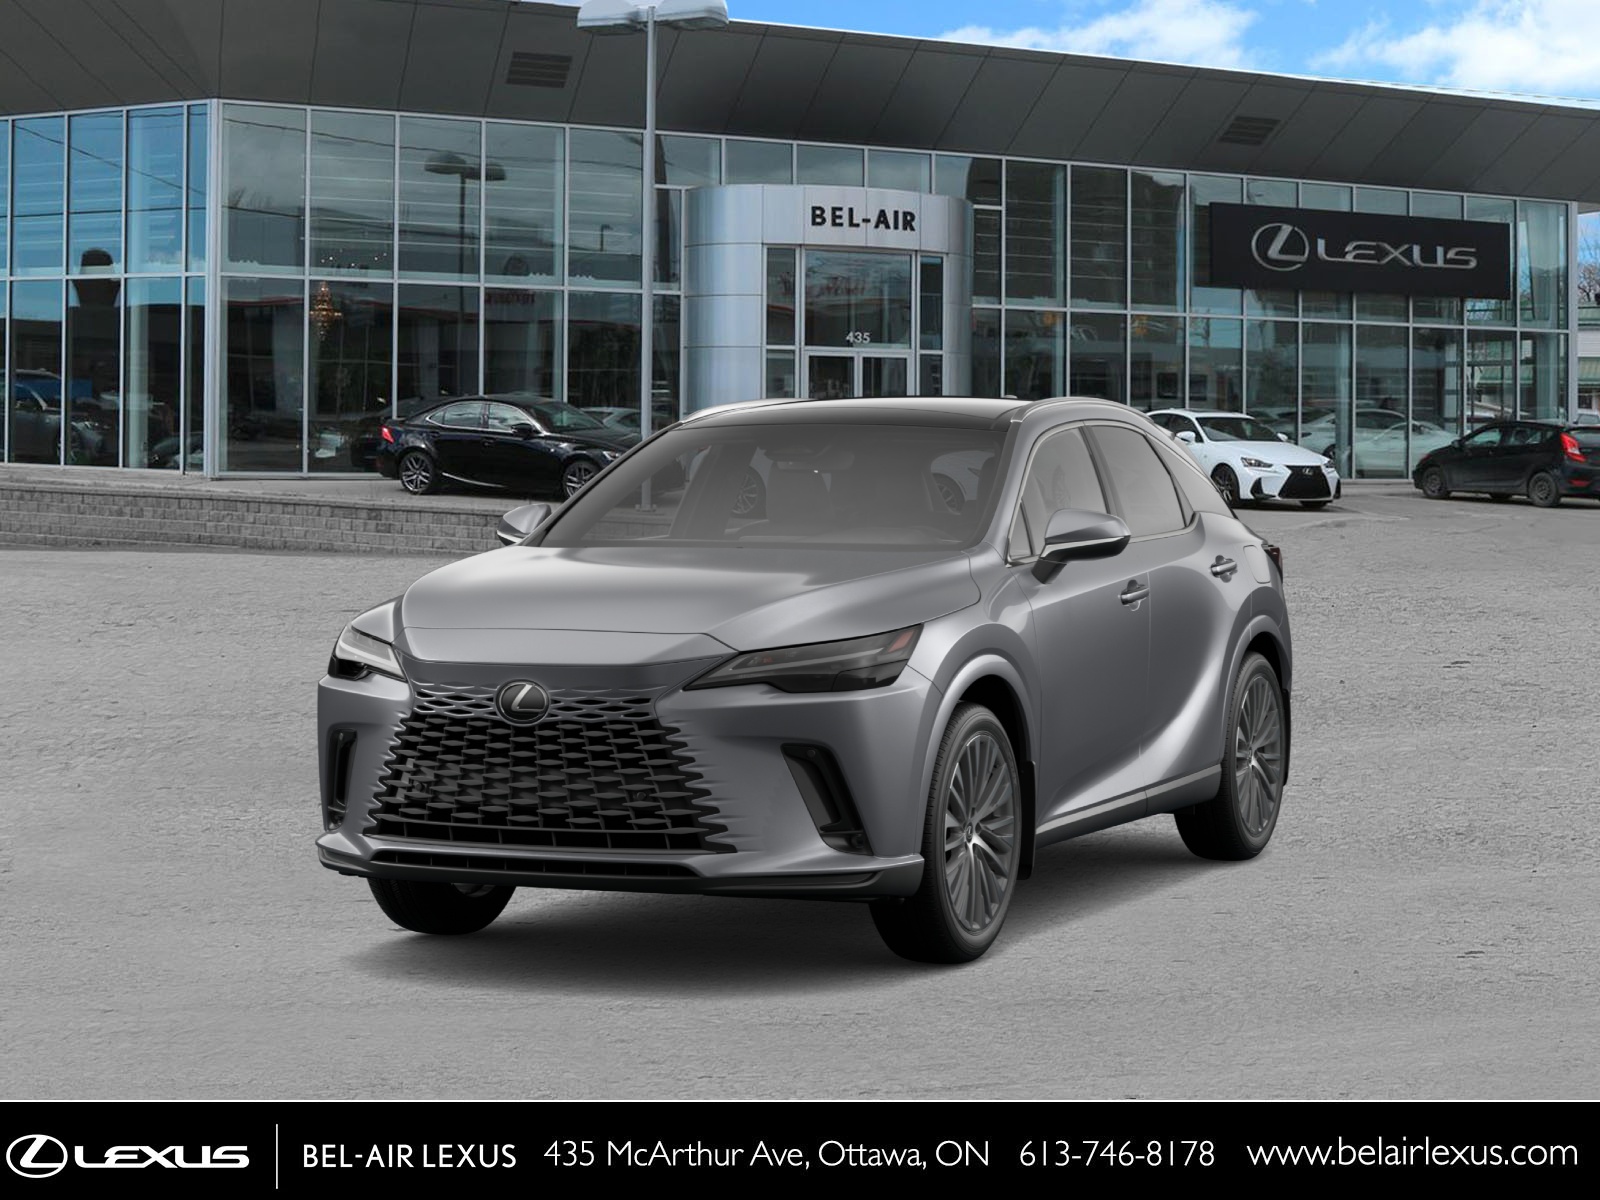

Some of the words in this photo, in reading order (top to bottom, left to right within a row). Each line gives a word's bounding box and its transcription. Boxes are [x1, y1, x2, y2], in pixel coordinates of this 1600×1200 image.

[810, 205, 917, 232] BEL-AIR
[1316, 237, 1478, 270] LEXUS
[845, 331, 872, 344] 435
